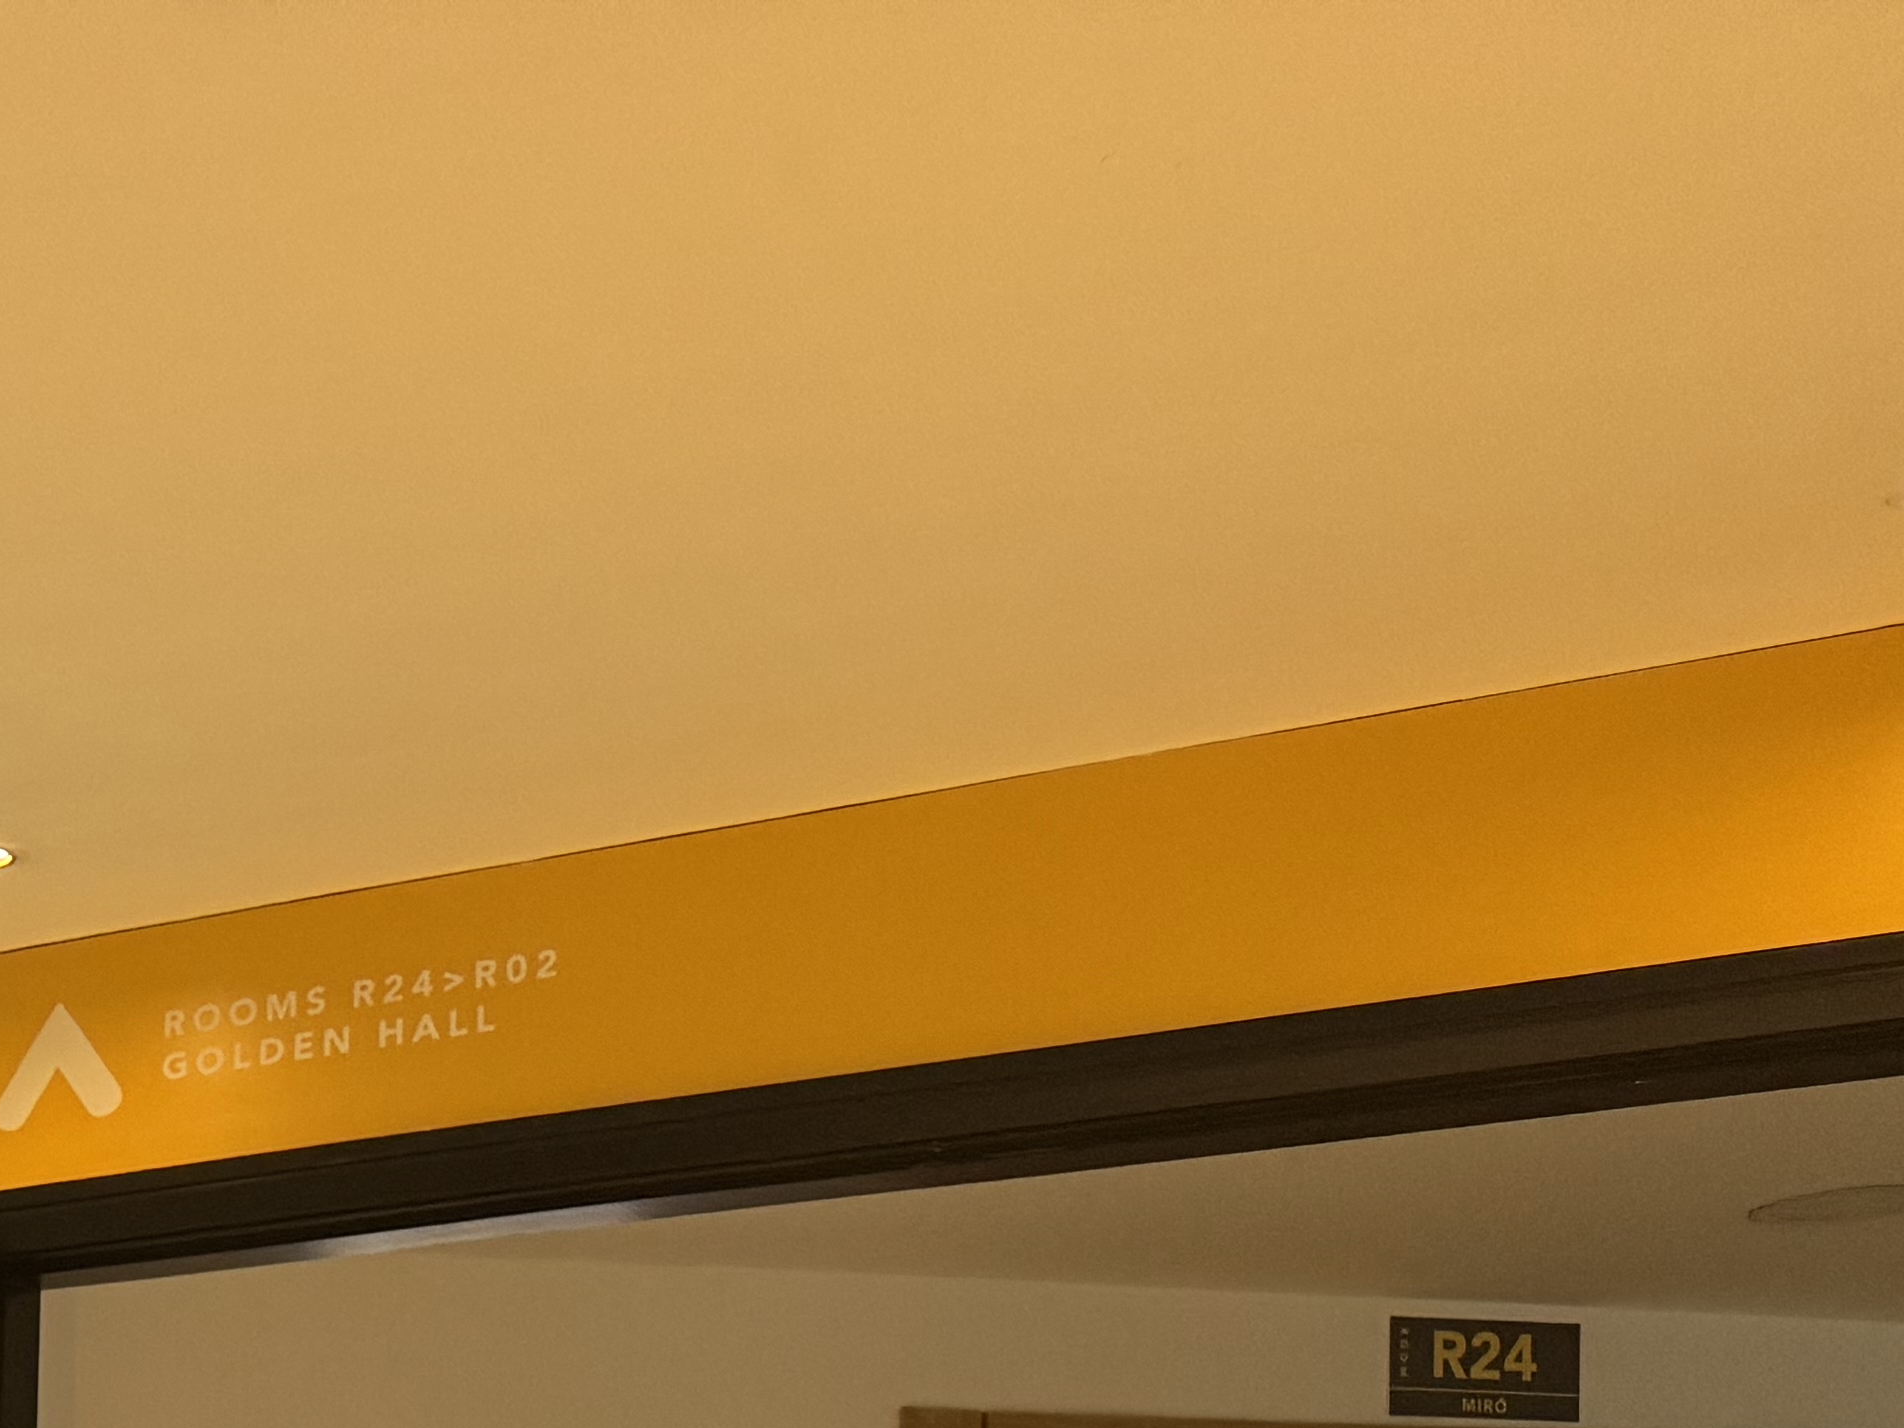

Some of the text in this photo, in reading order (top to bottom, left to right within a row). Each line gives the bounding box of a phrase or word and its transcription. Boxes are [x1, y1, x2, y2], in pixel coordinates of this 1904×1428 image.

[163, 985, 326, 1037] ROOMS
[162, 1005, 496, 1080] GOLDEN HALL
[1433, 1330, 1537, 1382] R24
